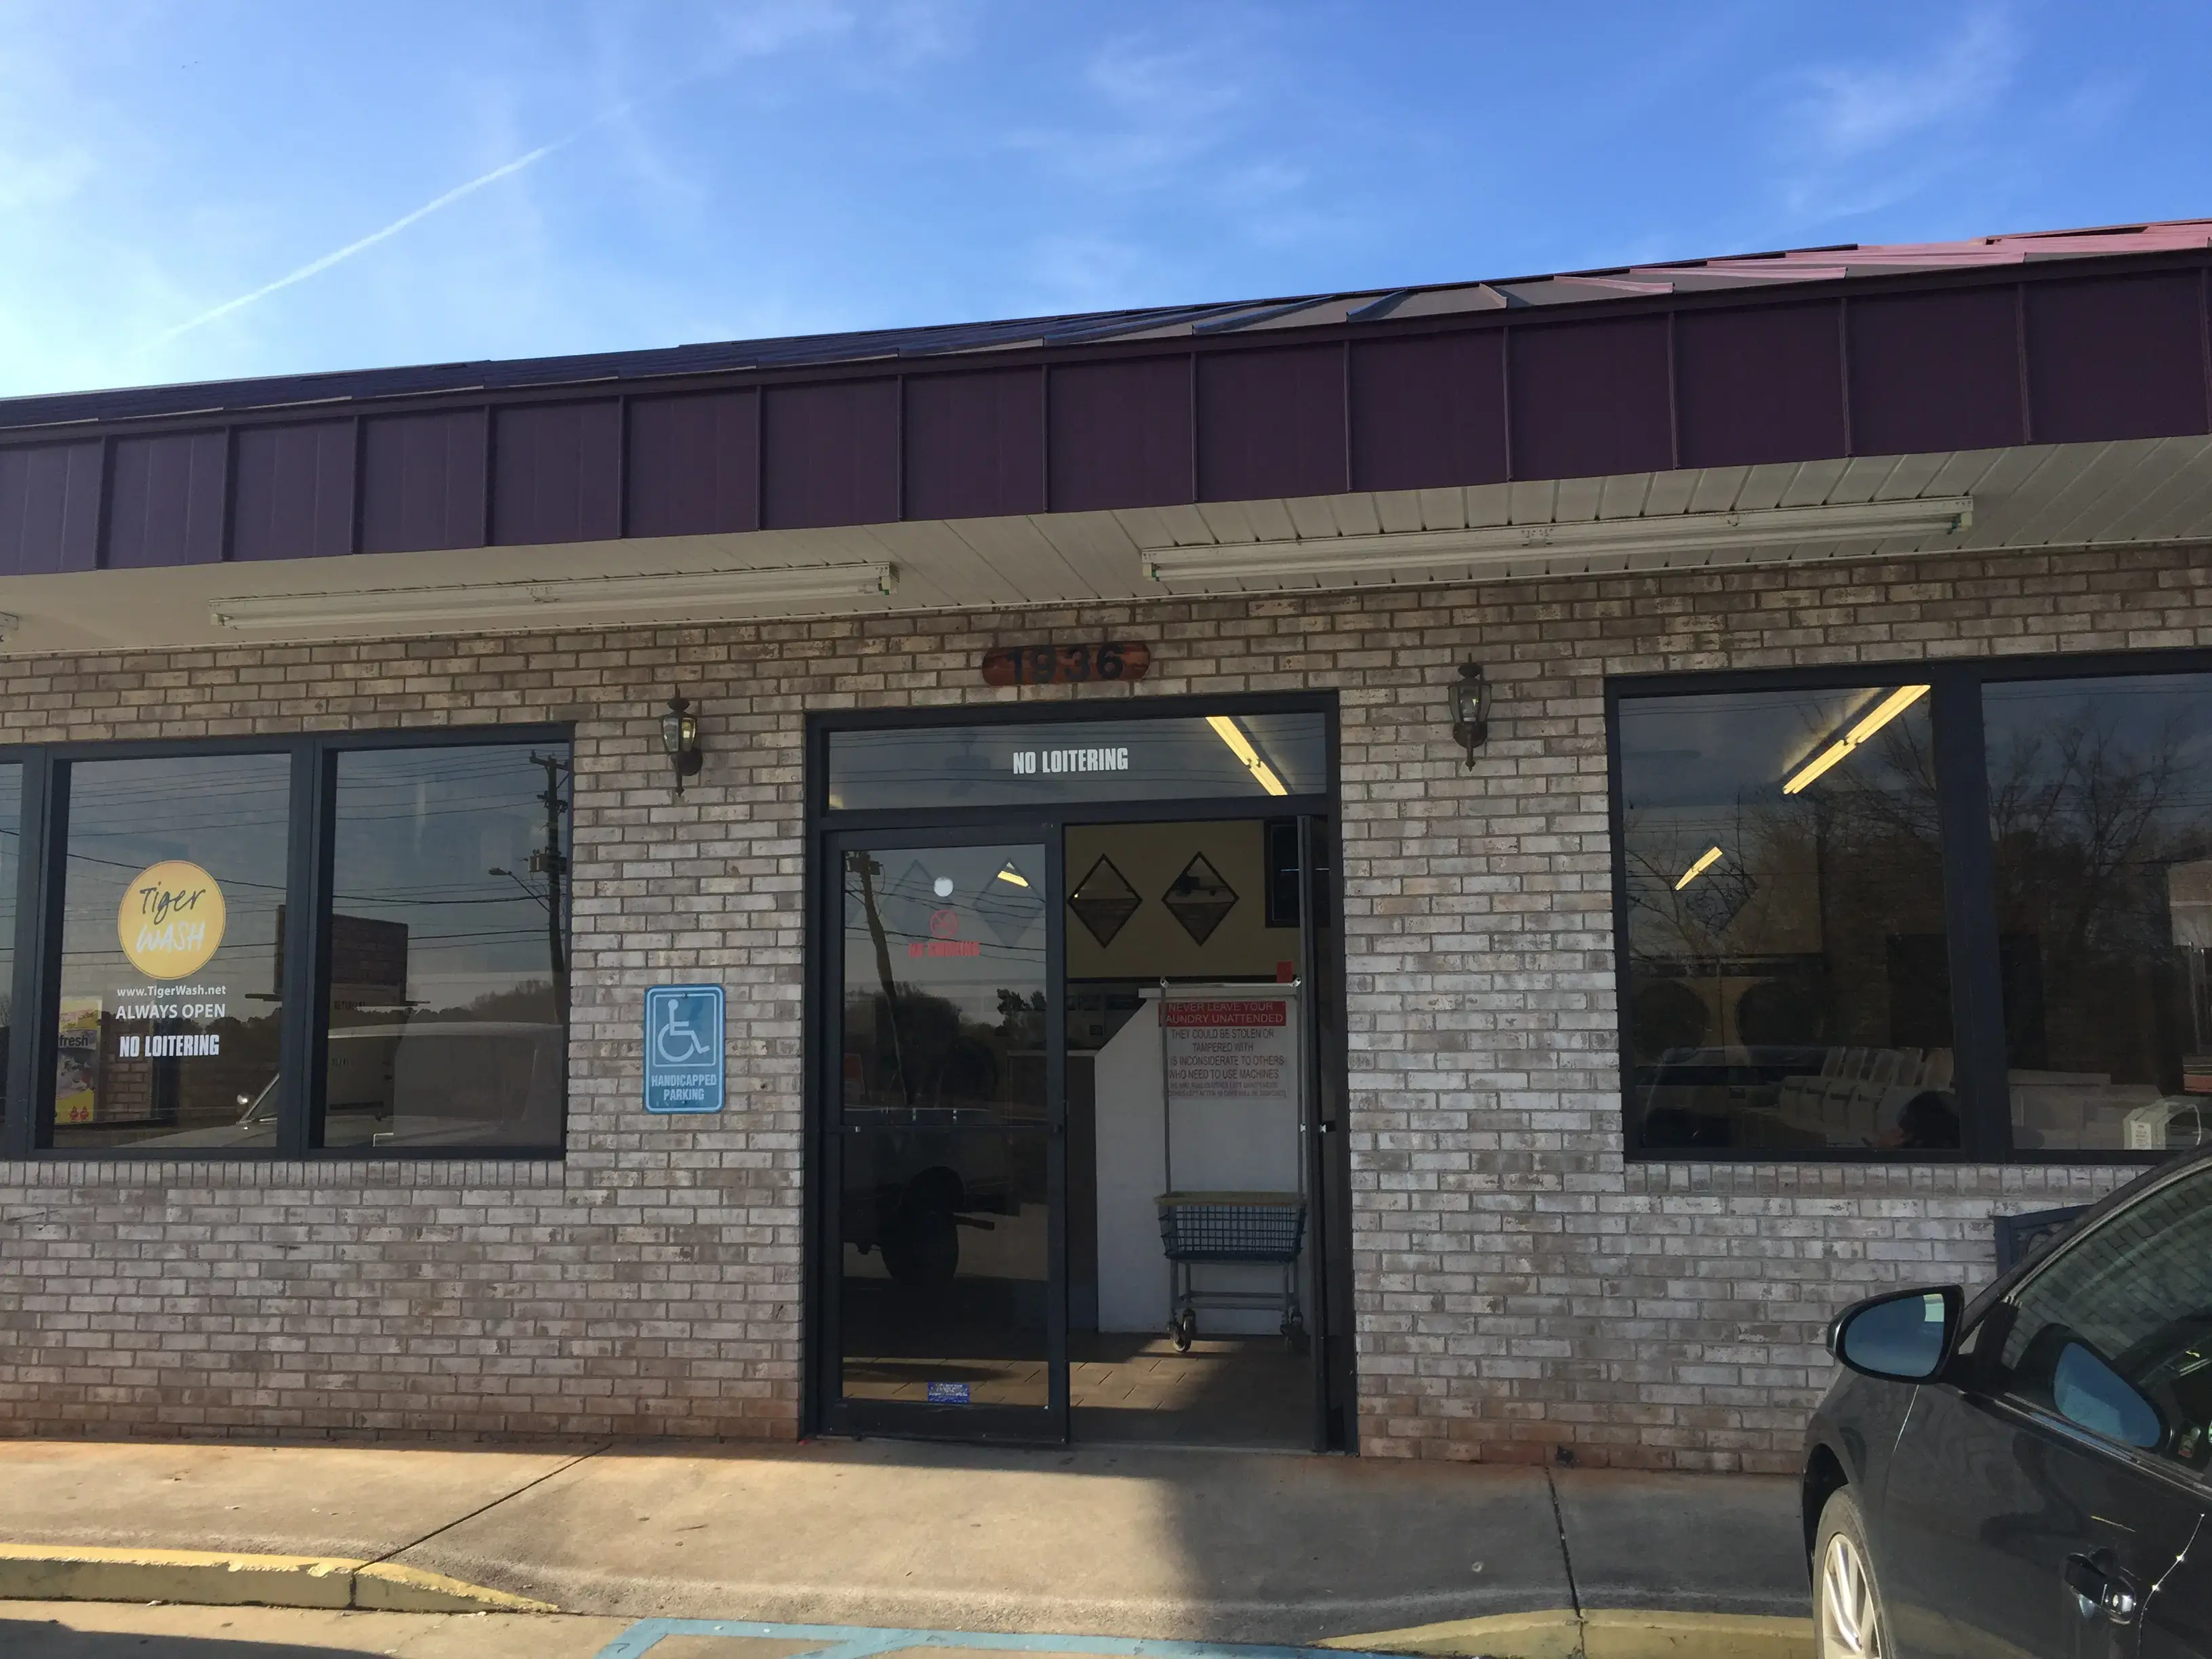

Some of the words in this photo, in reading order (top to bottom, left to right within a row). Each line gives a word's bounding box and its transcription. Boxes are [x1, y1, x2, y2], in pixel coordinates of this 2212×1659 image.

[1006, 644, 1124, 684] 1936
[1013, 752, 1036, 774] NO
[1042, 747, 1128, 773] LOITERING
[140, 881, 206, 926] Tiger
[136, 920, 205, 954] WASH
[117, 985, 226, 998] www.TigerWash.net
[115, 1004, 178, 1020] ALWAYS
[182, 1003, 226, 1018] OPEN
[1168, 1002, 1205, 1012] NEVER
[1208, 1002, 1242, 1011] LEAVE
[1243, 1001, 1273, 1011] YOUR
[1212, 1013, 1284, 1023] UNATTENDED
[1171, 1029, 1191, 1040] THEY
[1192, 1028, 1218, 1039] COULD
[1219, 1028, 1230, 1039] BE
[1231, 1028, 1261, 1039] STOLEN
[1263, 1027, 1274, 1038] OR
[59, 1034, 89, 1047] fresh
[119, 1036, 140, 1057] NO
[144, 1034, 220, 1057] LOITERING
[1191, 1042, 1233, 1052] TAMPERED
[1234, 1042, 1254, 1052] WITH
[1179, 1055, 1240, 1066] INCONSIDERATE
[1241, 1054, 1252, 1066] TO
[1253, 1054, 1285, 1066] OTHERS
[651, 1074, 717, 1087] HANDICAPPED
[1168, 1069, 1186, 1080] WHO
[1187, 1069, 1209, 1080] NEED
[1210, 1069, 1221, 1079] TO
[1222, 1069, 1237, 1080] USE
[1240, 1068, 1279, 1079] MACHINES
[663, 1088, 705, 1101] PARKING
